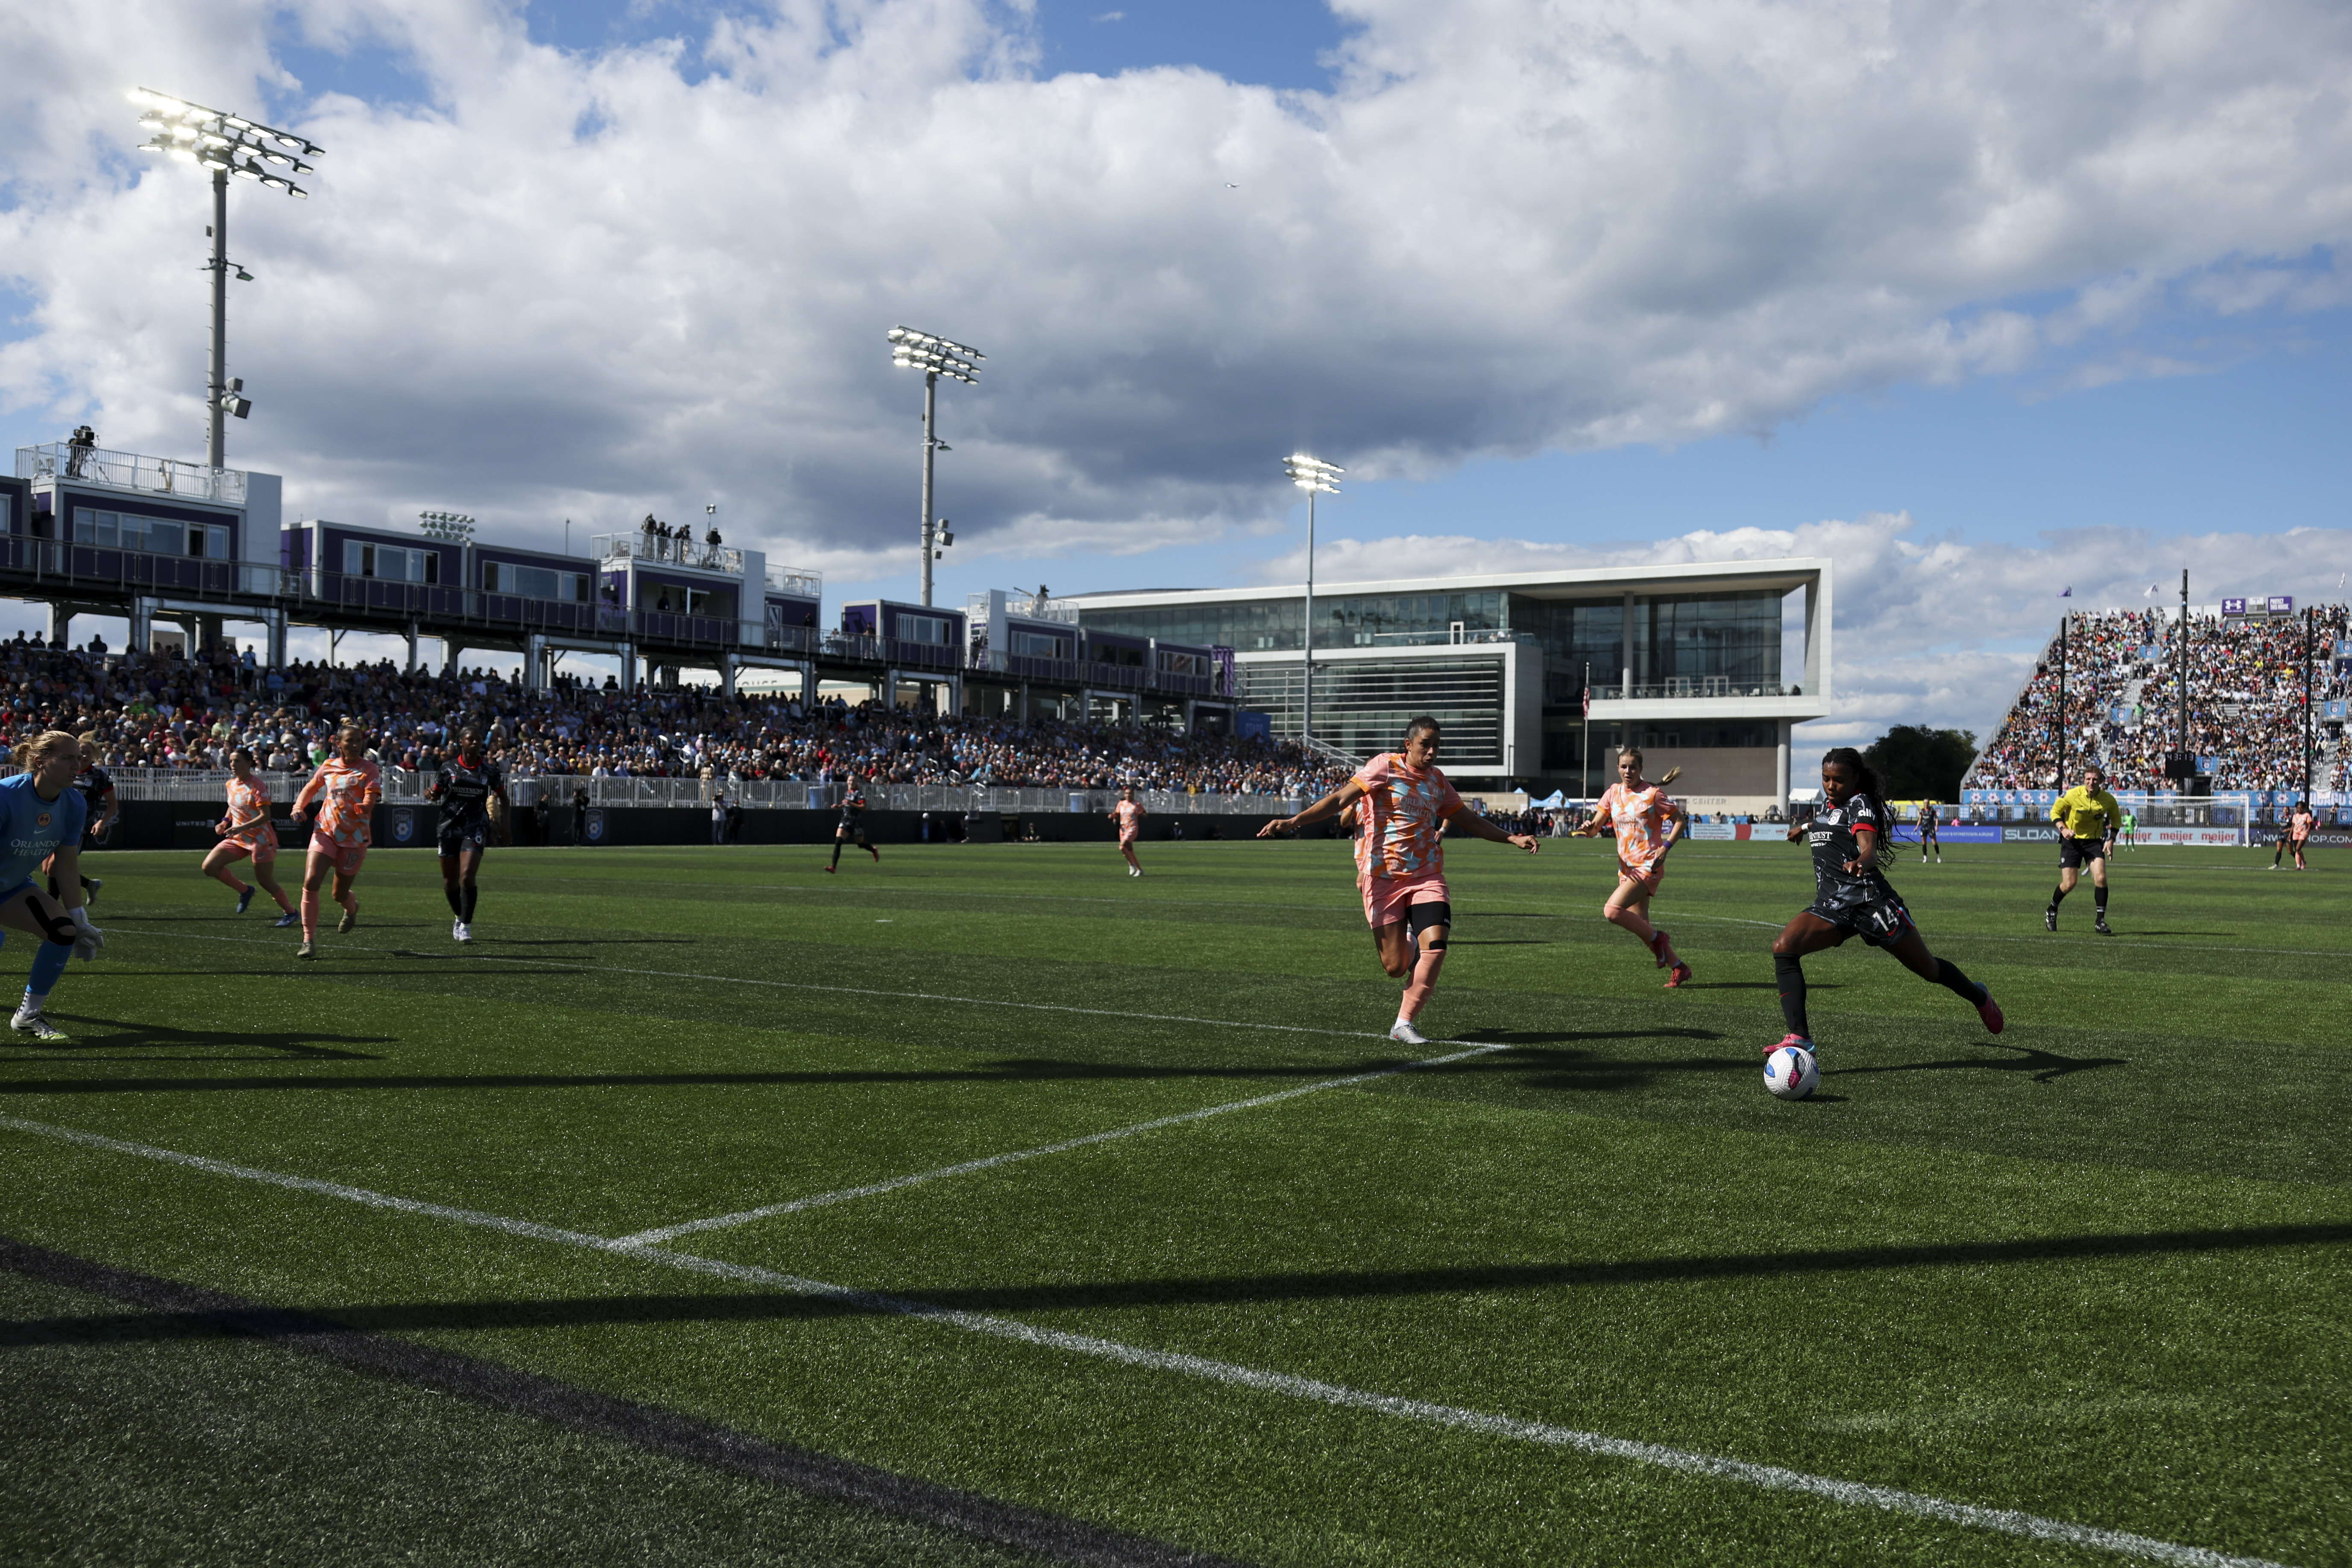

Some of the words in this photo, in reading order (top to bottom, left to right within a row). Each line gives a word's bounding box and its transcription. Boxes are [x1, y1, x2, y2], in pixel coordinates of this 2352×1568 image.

[2167, 753, 2194, 761] 43:13
[1858, 808, 1875, 821] ally
[2160, 831, 2193, 842] meijer
[2202, 831, 2235, 843] meijer
[11, 839, 60, 848] ORLANDO
[13, 848, 51, 856] HEALTH
[345, 853, 359, 867] 19
[1872, 904, 1899, 932] 14
